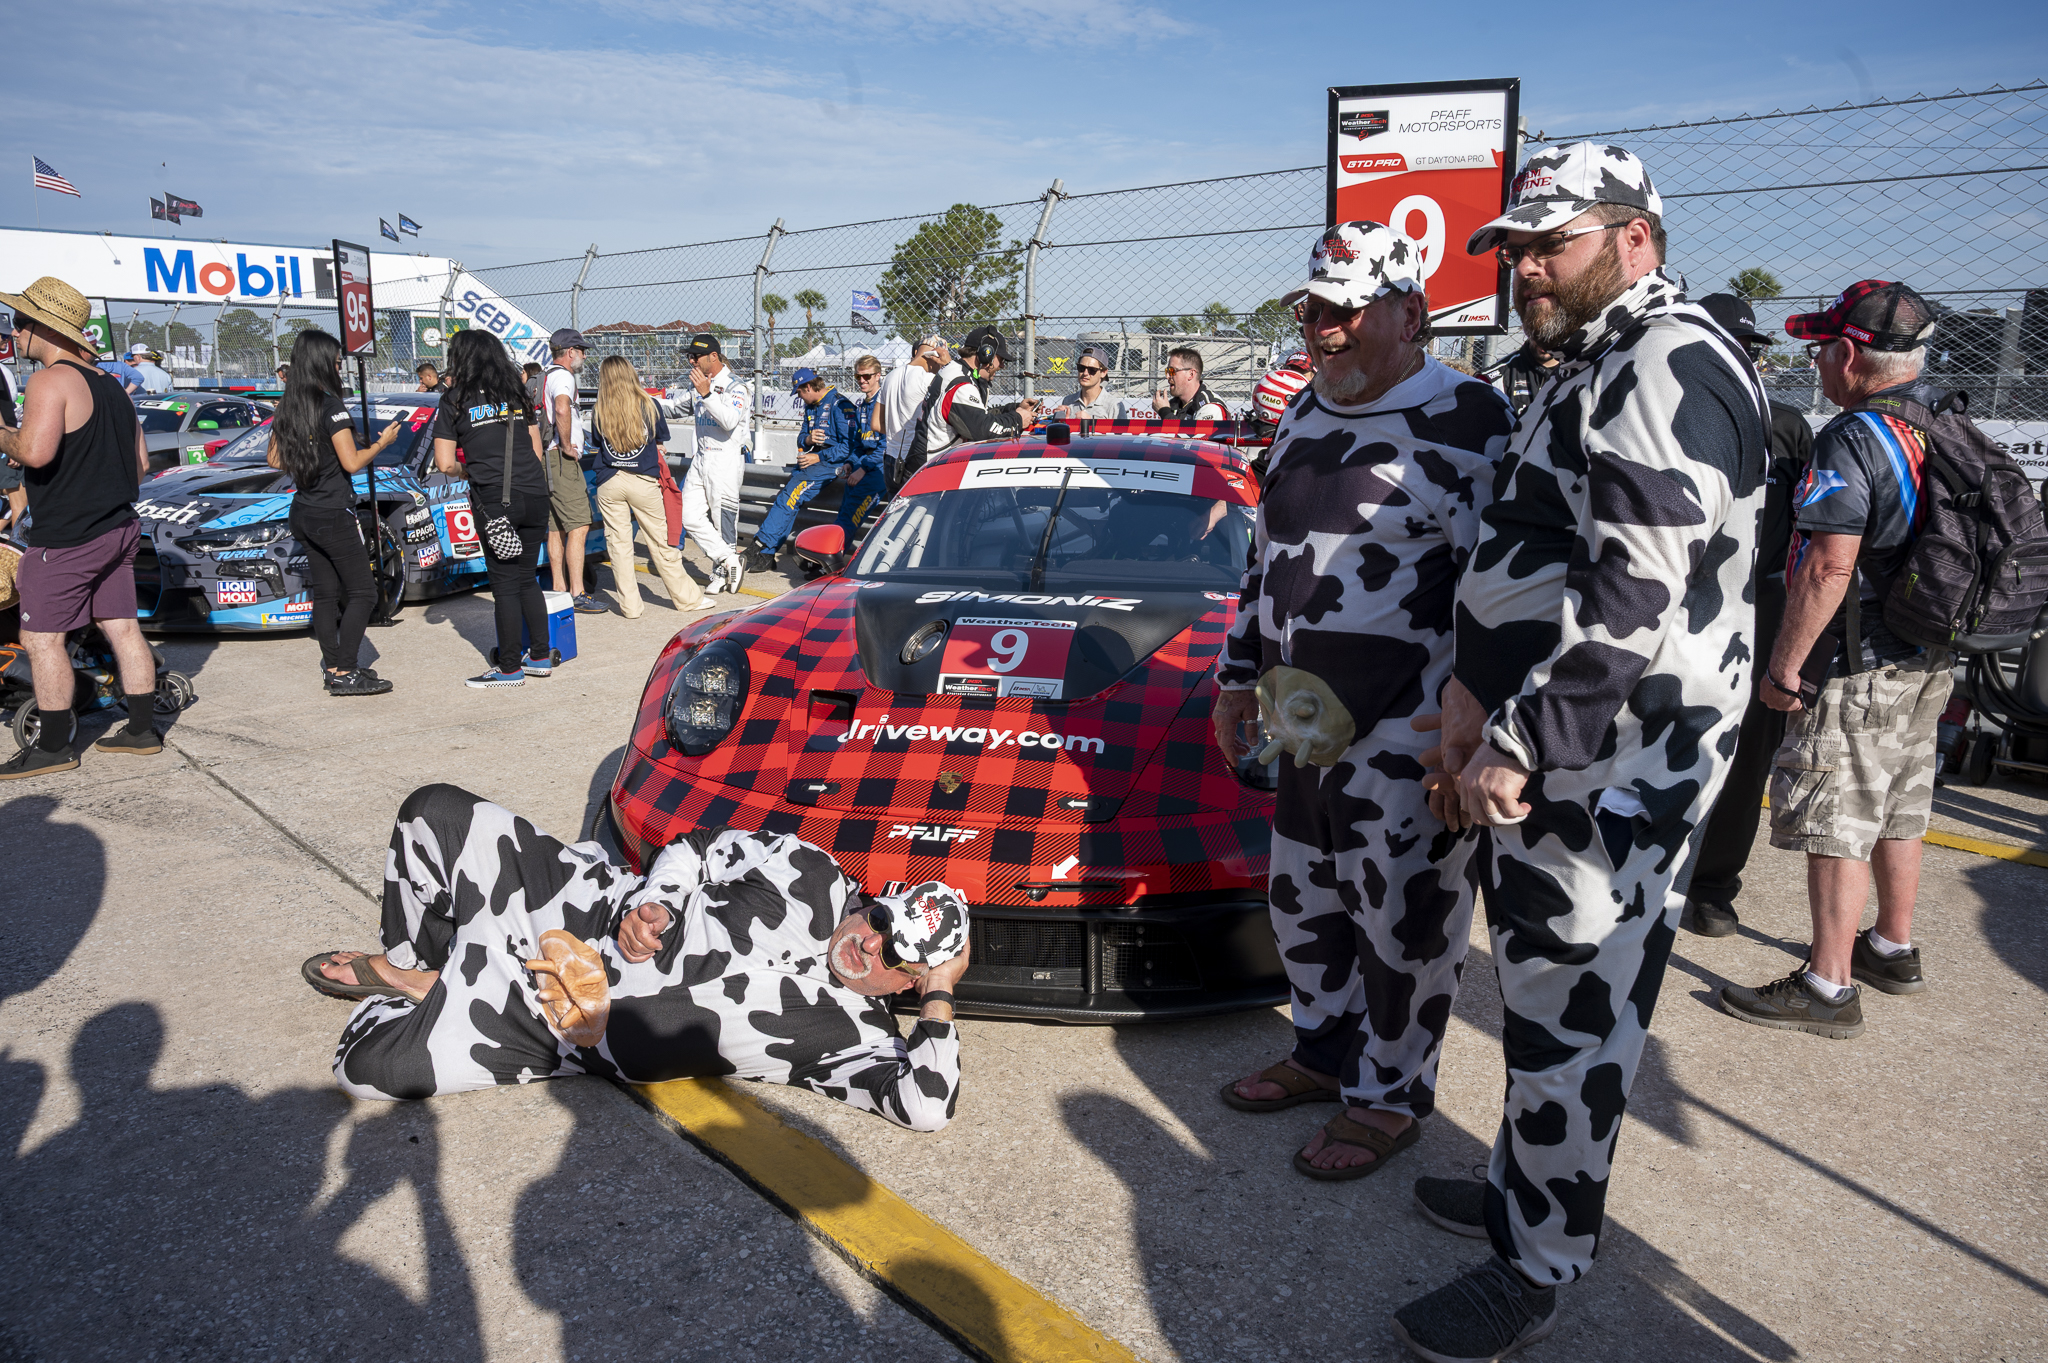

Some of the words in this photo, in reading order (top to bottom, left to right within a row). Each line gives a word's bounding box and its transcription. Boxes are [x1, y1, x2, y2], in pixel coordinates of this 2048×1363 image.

[1430, 109, 1472, 121] PFAFF
[1399, 119, 1502, 133] MOTORSPORTS
[1346, 160, 1373, 168] GTD
[1374, 158, 1402, 167] PRO
[1415, 156, 1426, 165] GT
[1428, 155, 1466, 164] DAYTONA
[1467, 154, 1485, 162] PRO
[1324, 239, 1352, 248] TEAM
[1389, 194, 1446, 280] 9
[1315, 248, 1361, 261] BOVINE
[143, 247, 303, 298] Mobil
[346, 291, 369, 333] 95
[1845, 326, 1871, 342] MOTUL
[1262, 394, 1282, 406] PAMO
[976, 466, 1180, 482] PORSCHE
[415, 522, 435, 538] PAGID
[217, 549, 268, 560] TURNER
[419, 542, 439, 558] LIQUI
[420, 552, 441, 567] MOLY
[219, 581, 255, 592] LIQUI
[220, 592, 255, 602] MOLY
[915, 591, 1143, 611] SIMONIZ
[286, 602, 313, 612] MOTU
[279, 613, 312, 621] MICHELI
[961, 618, 1072, 628] WeatherTech
[986, 628, 1029, 673] 9
[945, 684, 997, 692] WeatherTech
[887, 824, 980, 843] PFAFF
[915, 895, 938, 934] BOVINE
[928, 897, 942, 922] TEAM
